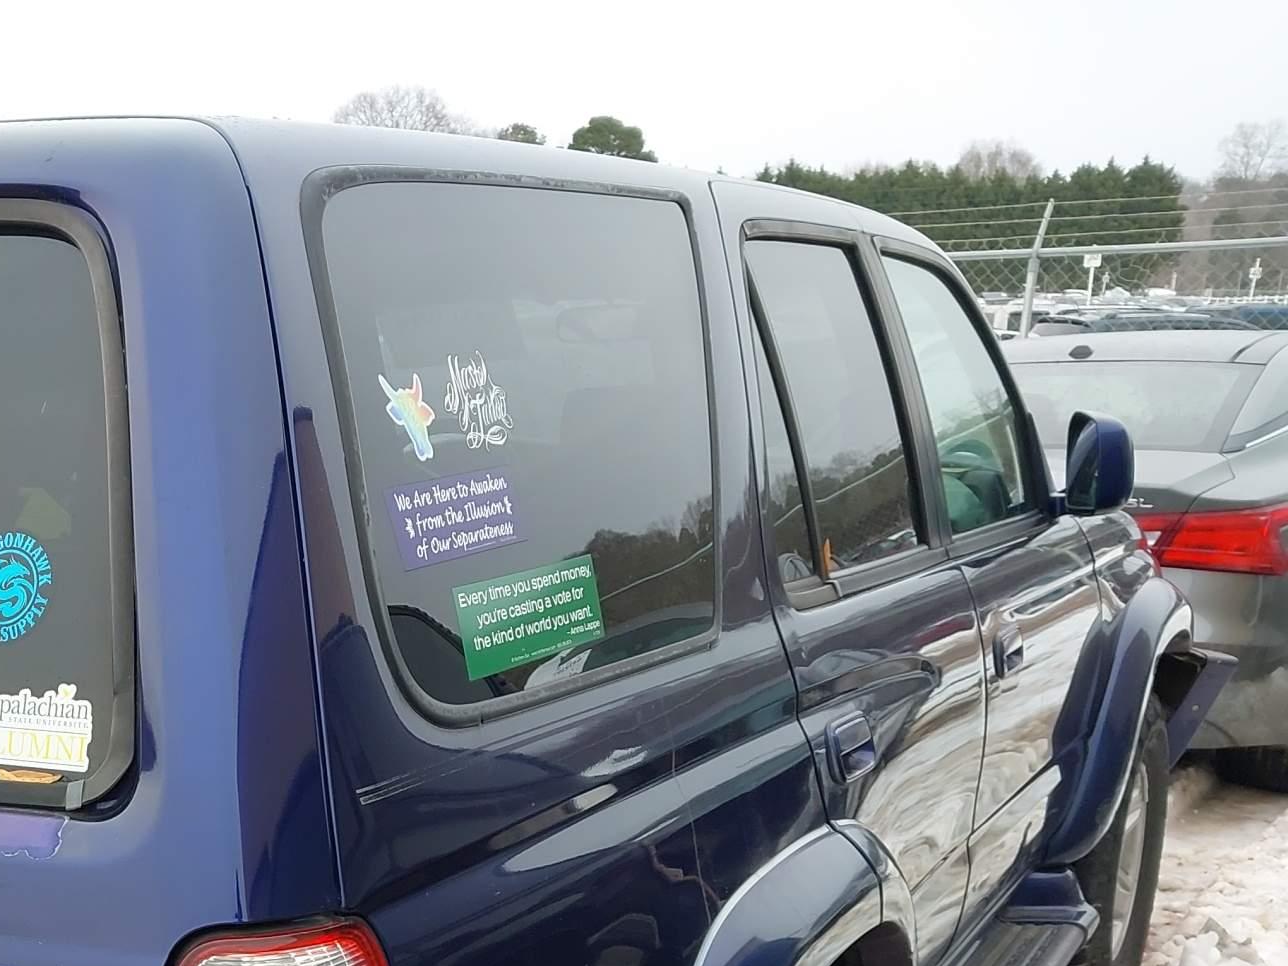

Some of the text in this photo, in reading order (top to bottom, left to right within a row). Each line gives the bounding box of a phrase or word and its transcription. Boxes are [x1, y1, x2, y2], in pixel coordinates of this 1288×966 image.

[393, 473, 508, 512] We Are Here to Awaken
[415, 501, 505, 537] from the Illusion
[416, 540, 430, 560] of
[430, 535, 453, 555] Our
[452, 520, 514, 552] Separateness
[458, 562, 593, 609] Every time you spend money,
[476, 585, 585, 630] you're casting a vote for
[0, 593, 49, 642] SUPPLY
[473, 632, 492, 652] the
[491, 626, 515, 646] kind
[514, 621, 526, 640] of
[525, 615, 553, 637] world
[552, 612, 570, 631] you
[569, 604, 594, 623] want.
